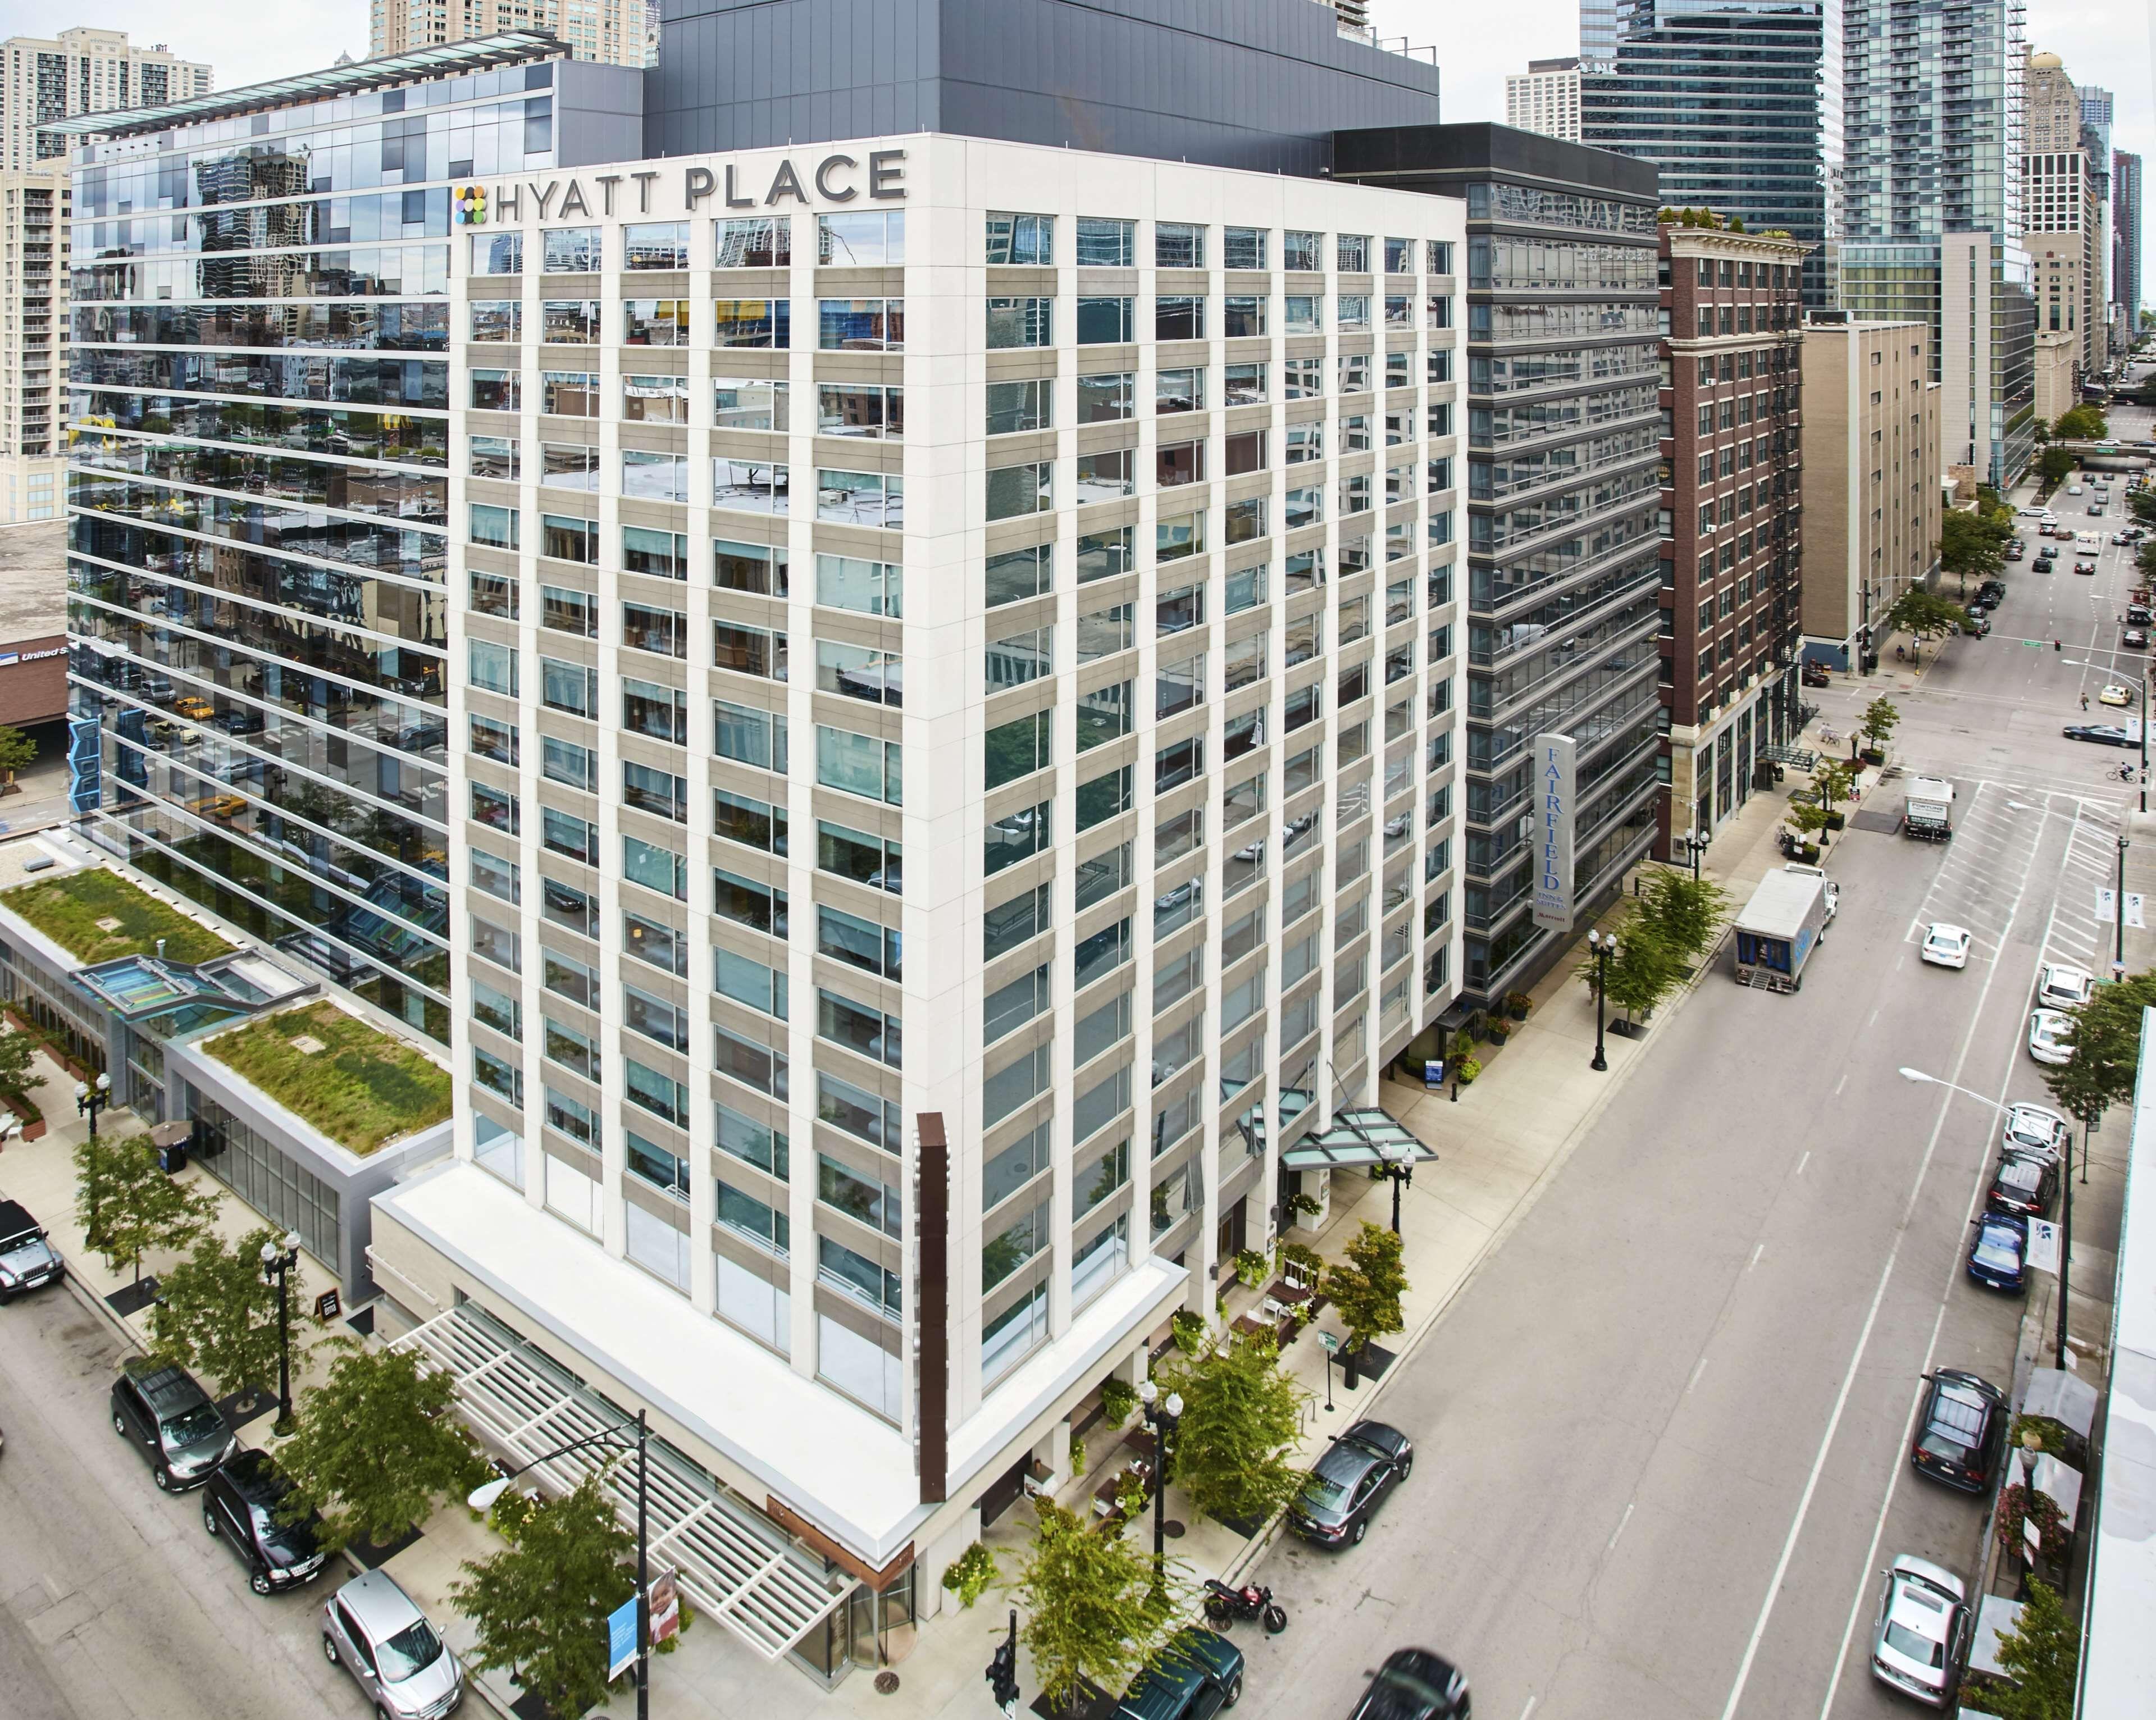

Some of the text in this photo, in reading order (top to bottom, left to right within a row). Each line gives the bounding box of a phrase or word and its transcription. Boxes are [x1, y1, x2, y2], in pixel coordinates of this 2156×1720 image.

[495, 149, 908, 223] HYATT PLACE
[21, 648, 59, 661] United
[1543, 747, 1564, 891] FAIRFIELD
[1537, 912, 1565, 922] Marriott
